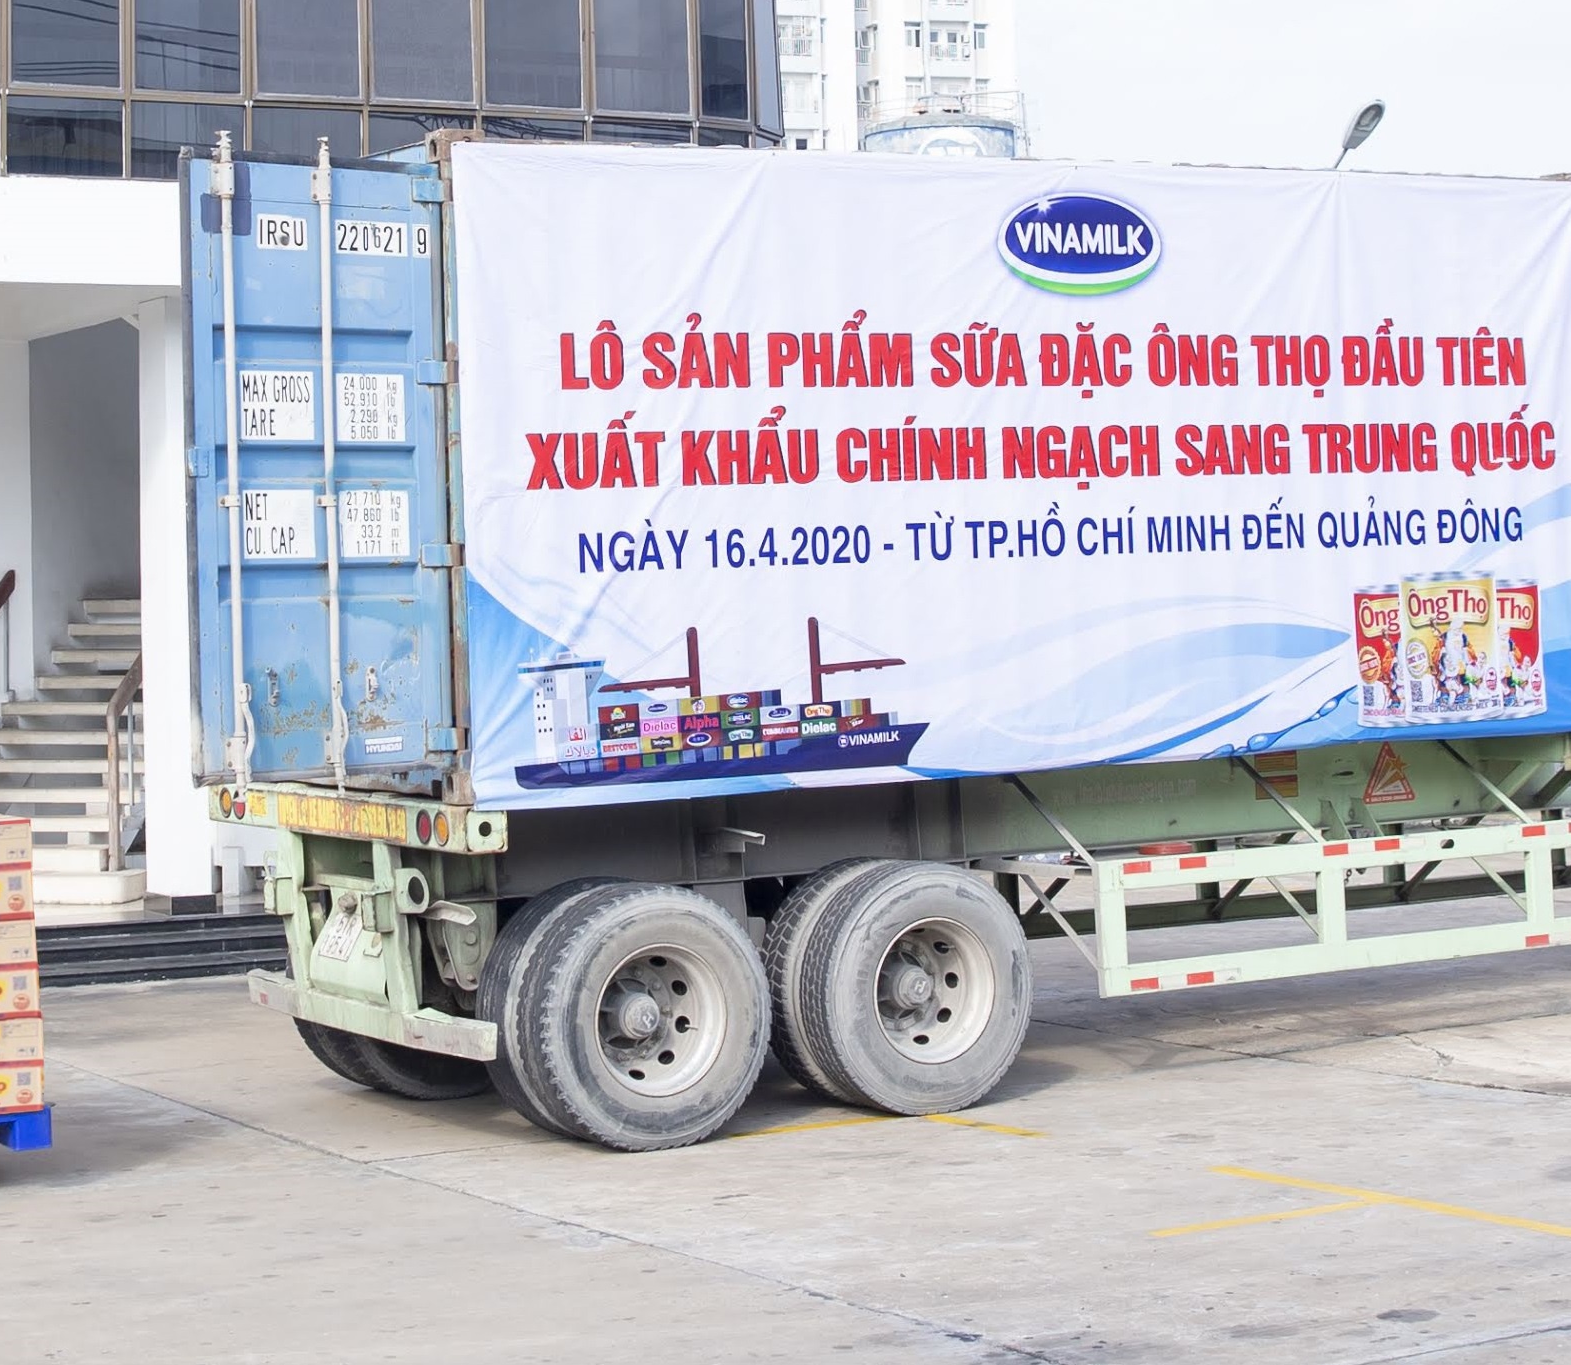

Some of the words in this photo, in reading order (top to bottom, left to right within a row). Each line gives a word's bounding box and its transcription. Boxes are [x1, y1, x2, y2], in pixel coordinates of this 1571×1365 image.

[259, 218, 305, 246] IRSU
[417, 228, 427, 254] 9
[1014, 222, 1147, 256] VINAMILK
[559, 320, 624, 390] LÔ
[642, 312, 750, 389] SẢN
[767, 309, 914, 388] PHẨM
[930, 322, 1028, 388] SỮA
[1038, 321, 1132, 399] ĐẶC
[1147, 322, 1239, 387] ÔNG
[1250, 335, 1331, 398] THỌ
[1341, 318, 1424, 387] ĐẦU
[1436, 326, 1527, 387] TIÊN
[242, 374, 268, 403] MAX
[273, 375, 311, 404] GROSS
[343, 376, 378, 391] 24.000
[386, 376, 398, 393] kg
[243, 408, 277, 437] TARE
[387, 409, 399, 428] kg
[526, 410, 666, 490] XUẤT
[681, 405, 820, 487] KHẨU
[835, 415, 988, 484] CHÍNH
[1002, 422, 1160, 491] NGẠCH
[1175, 424, 1291, 476] SANG
[1302, 422, 1439, 474] TRUNG
[1451, 403, 1557, 478] QUỐC
[245, 493, 268, 521] NET
[390, 491, 402, 509] kg
[246, 527, 266, 555] CU.
[271, 526, 298, 555] CAP.
[578, 519, 690, 574] NGÀY
[705, 524, 871, 569] 16.4.2020
[906, 510, 955, 561] TỪ
[966, 501, 1065, 559] TP.HỒ
[1077, 506, 1135, 557] CHÍ
[1147, 513, 1230, 555] MINH
[1242, 497, 1305, 551] ĐẾN
[1317, 495, 1427, 550] QUẢNG
[1436, 497, 1524, 543] ĐÔNG
[643, 720, 677, 733] Dielac
[684, 716, 720, 732] Alpha
[801, 721, 837, 734] Dielac
[365, 743, 403, 755] HYUNDAI
[849, 731, 900, 746] VINAMILK
